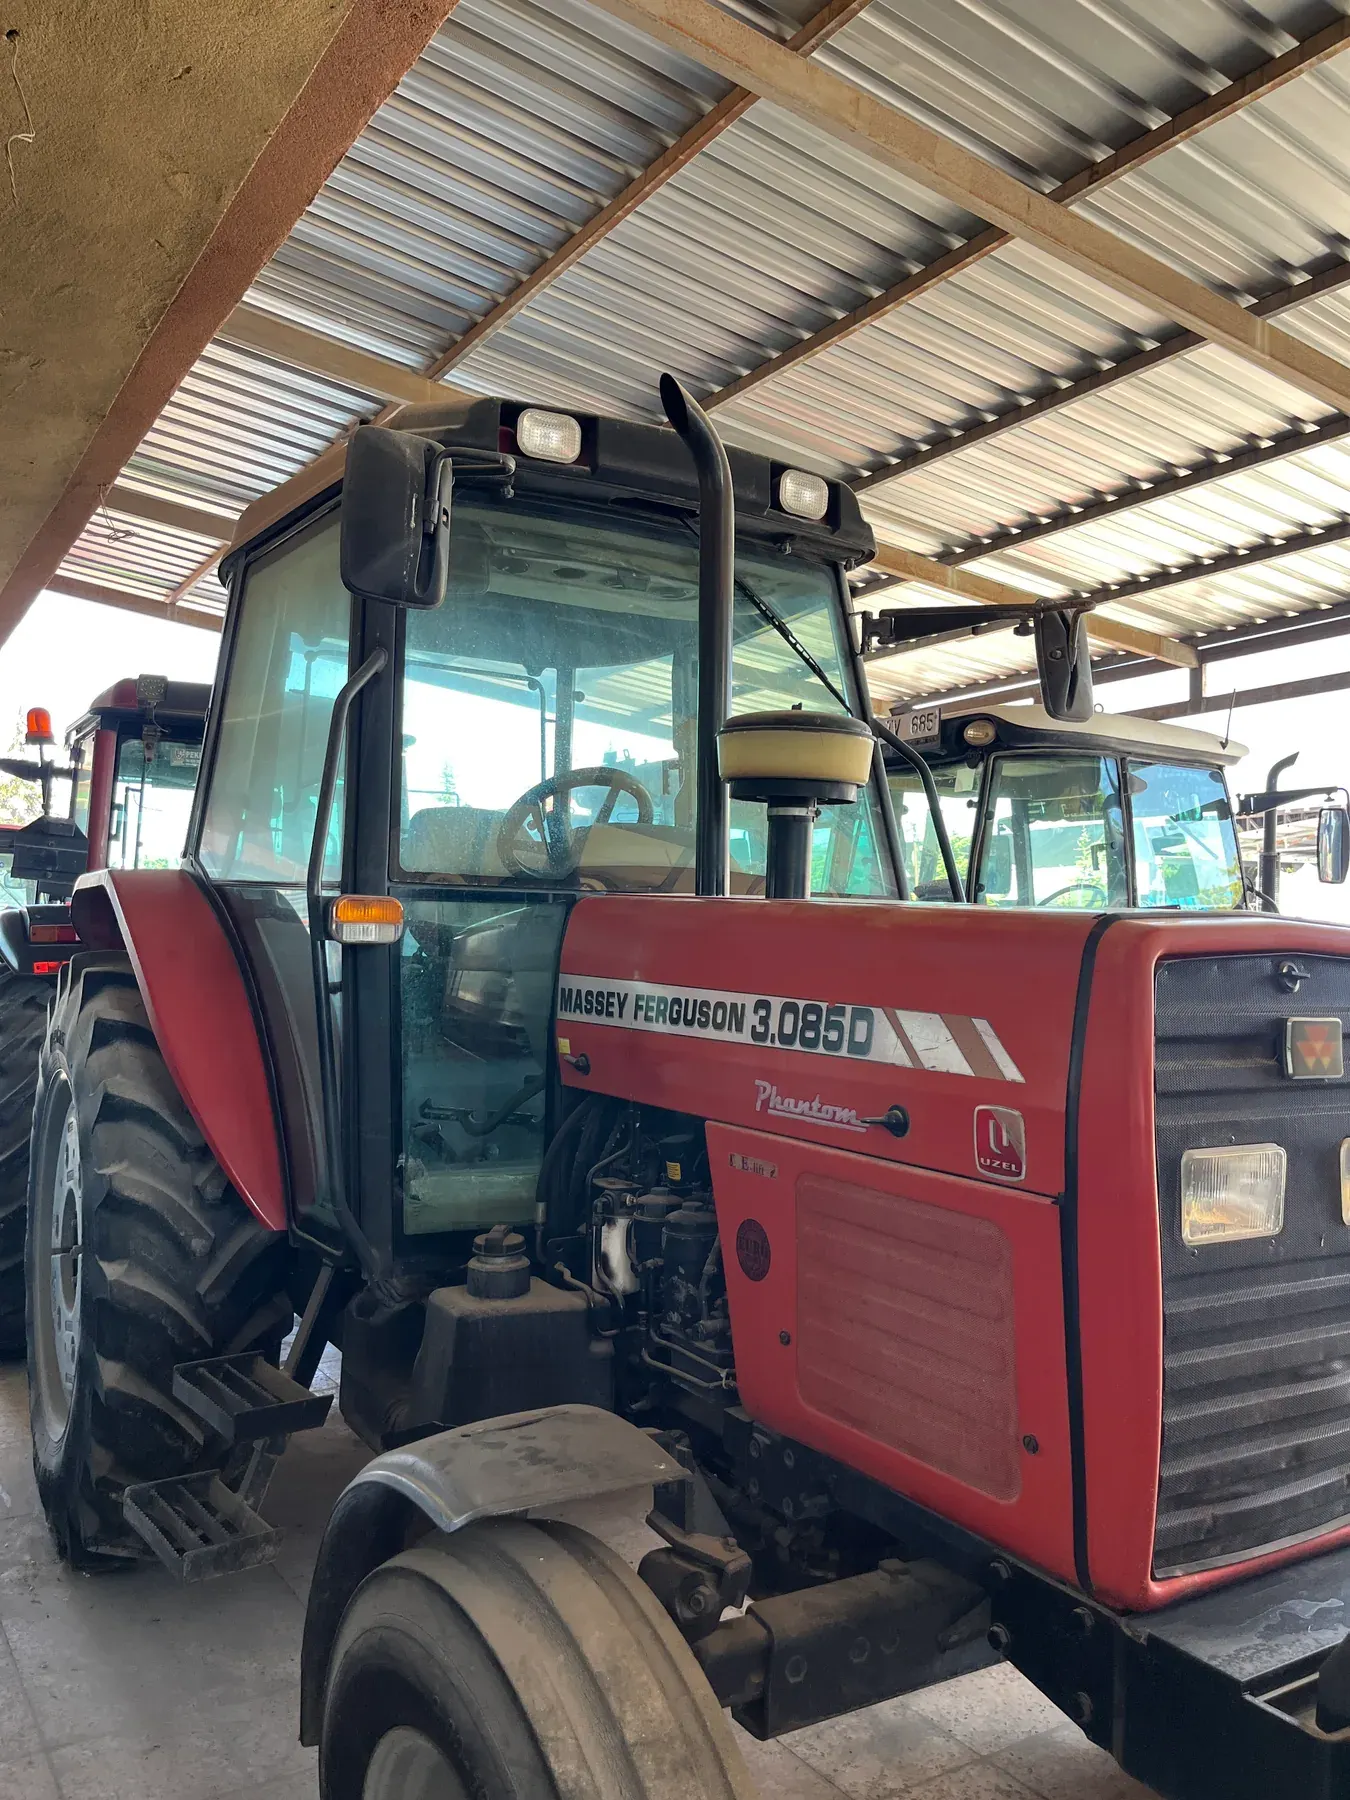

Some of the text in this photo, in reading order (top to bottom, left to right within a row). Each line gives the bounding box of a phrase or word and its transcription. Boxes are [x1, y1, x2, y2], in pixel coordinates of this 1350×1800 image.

[911, 713, 934, 735] 685
[560, 987, 875, 1056] MASSEY FERGUSON 3.085D
[754, 1079, 869, 1129] Phantom
[980, 1157, 1020, 1173] UZEL
